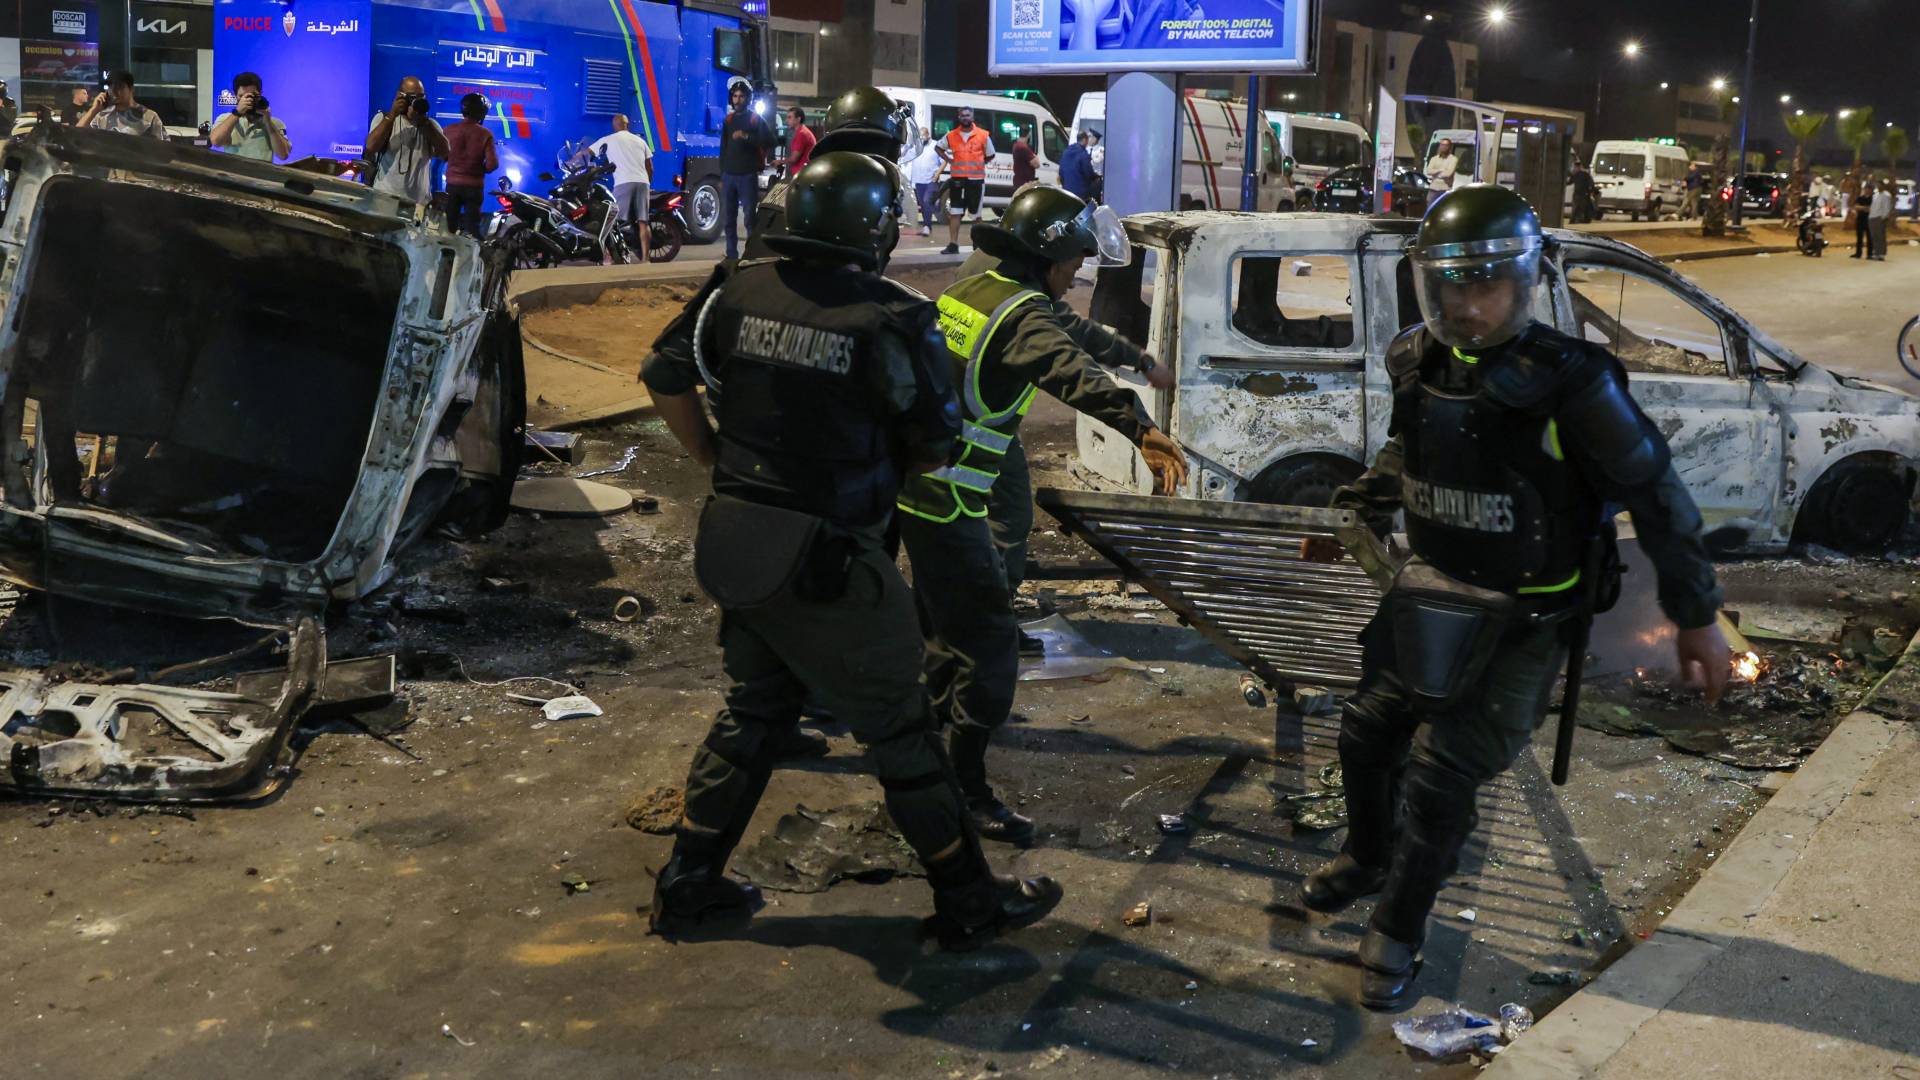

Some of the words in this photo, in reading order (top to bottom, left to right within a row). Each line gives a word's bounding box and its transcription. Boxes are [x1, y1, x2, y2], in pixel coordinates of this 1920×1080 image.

[136, 18, 187, 34] KIA
[224, 17, 272, 31] POLICE
[306, 19, 358, 35] الشرطة
[1160, 20, 1202, 30] FORFAIT
[1202, 19, 1230, 29] 100%
[1231, 18, 1273, 28] DIGITAL
[1002, 31, 1023, 39] SCAN
[1167, 31, 1183, 40] BY
[1183, 30, 1222, 40] MAROC
[1224, 29, 1274, 39] TELECOM
[454, 45, 500, 68] الوطني
[736, 315, 781, 358] FORCES
